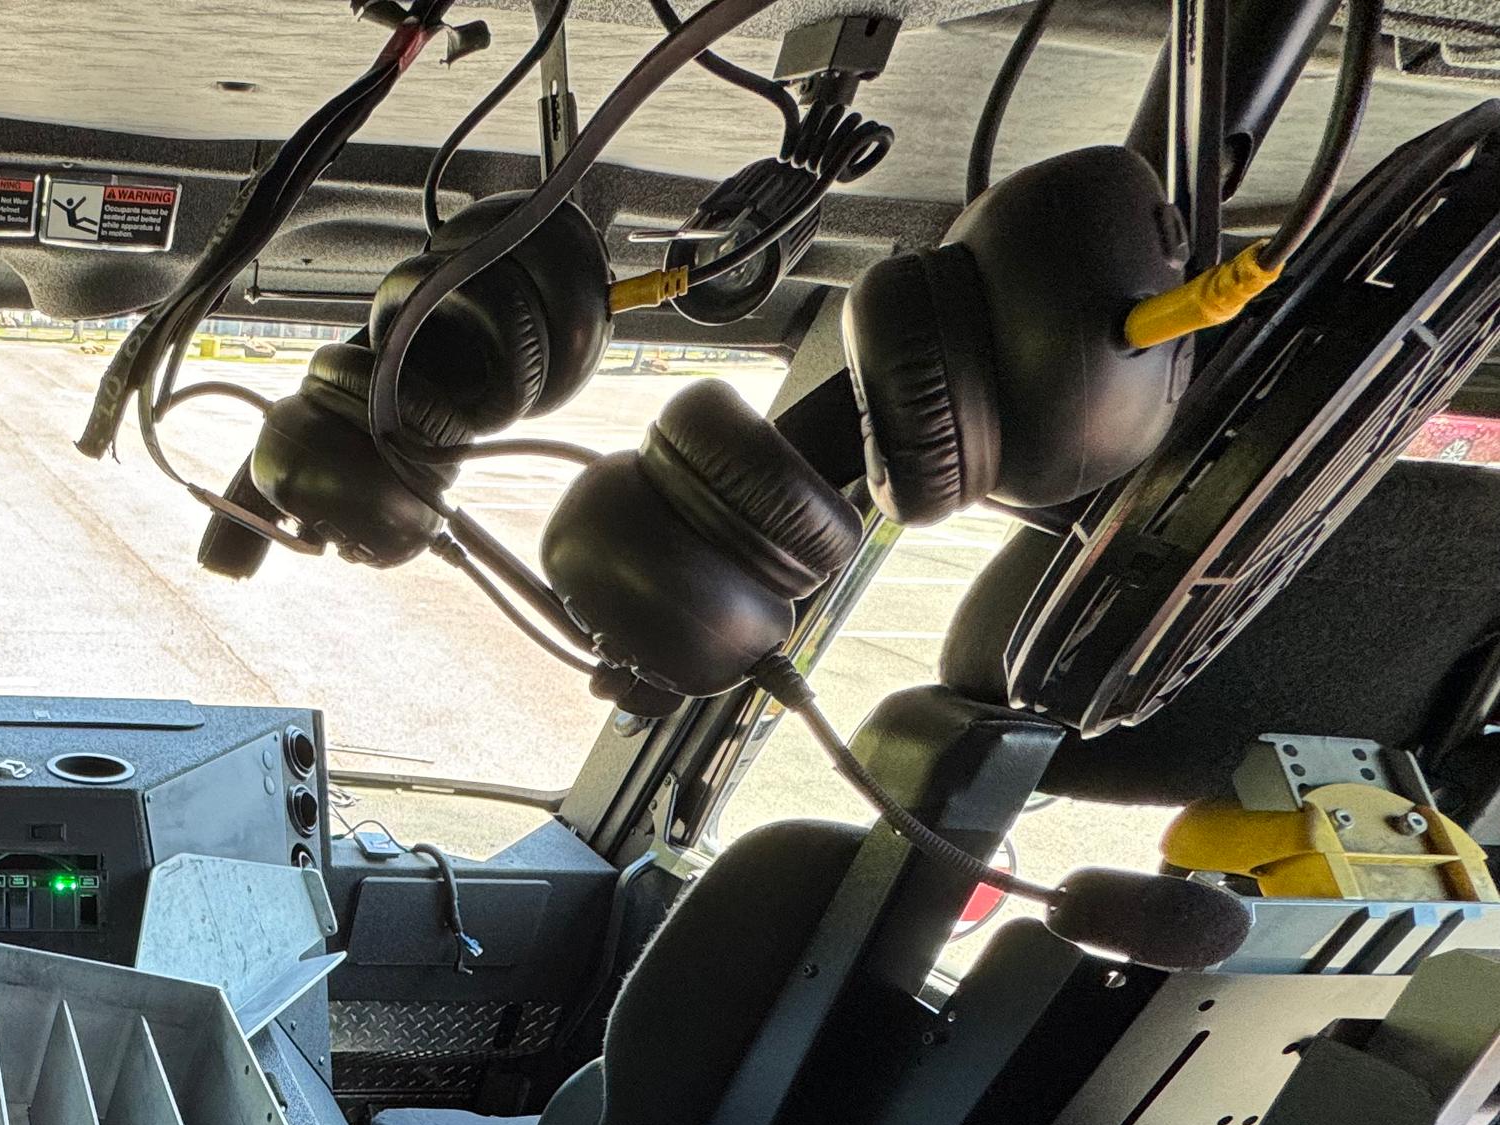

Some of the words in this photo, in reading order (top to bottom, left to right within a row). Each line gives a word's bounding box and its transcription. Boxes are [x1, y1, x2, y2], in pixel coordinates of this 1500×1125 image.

[13, 197, 29, 205] Wear
[118, 189, 171, 203] WARNING
[104, 204, 140, 214] Occupants
[142, 208, 159, 216] must
[160, 207, 169, 216] be
[7, 215, 28, 223] Seated
[103, 213, 125, 221] seated
[127, 214, 140, 222] and
[141, 215, 162, 223] belted
[102, 221, 119, 229] while
[121, 223, 153, 231] apparatus
[155, 224, 161, 232] is
[109, 230, 133, 238] motion.
